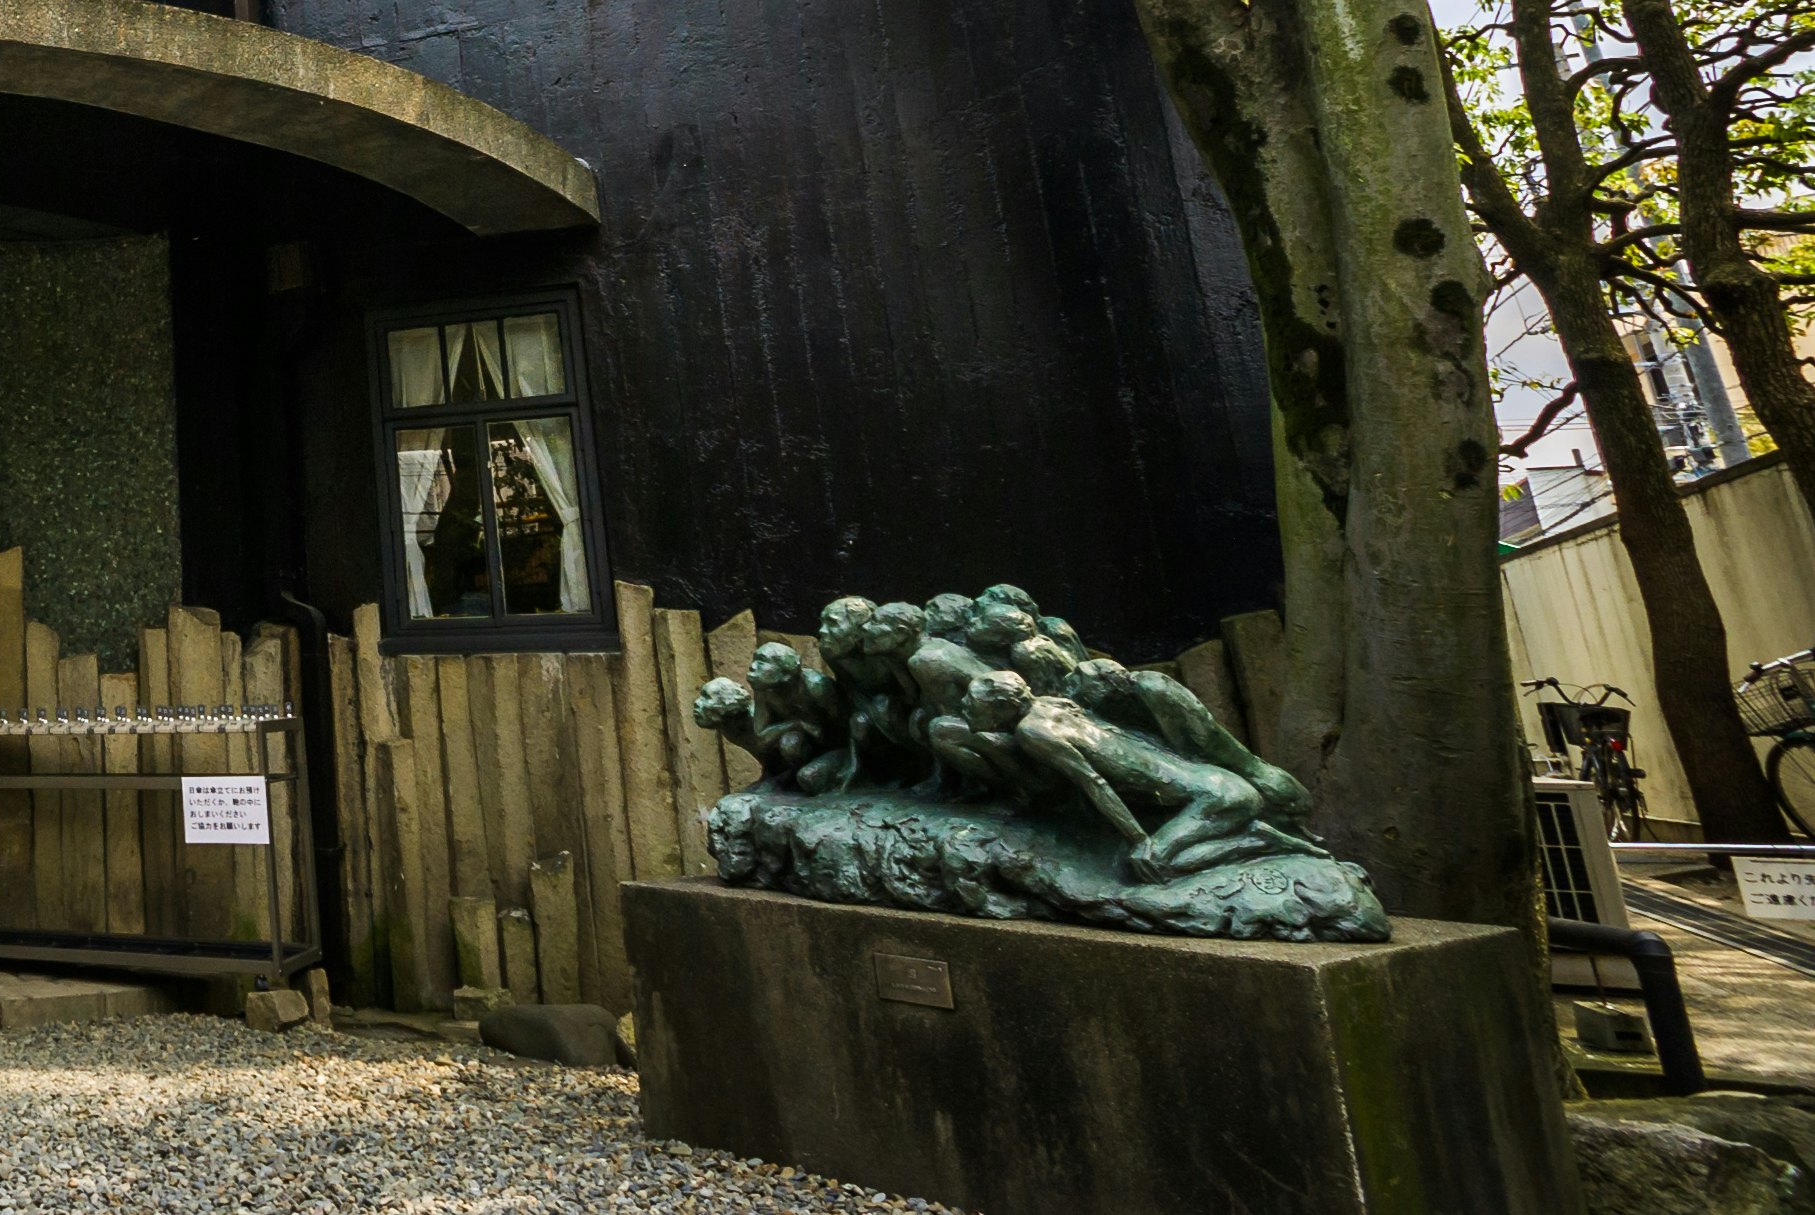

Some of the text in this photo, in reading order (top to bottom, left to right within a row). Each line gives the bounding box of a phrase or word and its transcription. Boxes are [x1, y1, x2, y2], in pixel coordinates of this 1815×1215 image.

[190, 810, 247, 819] おしまいください
[191, 822, 261, 831] ご協力をお願いします
